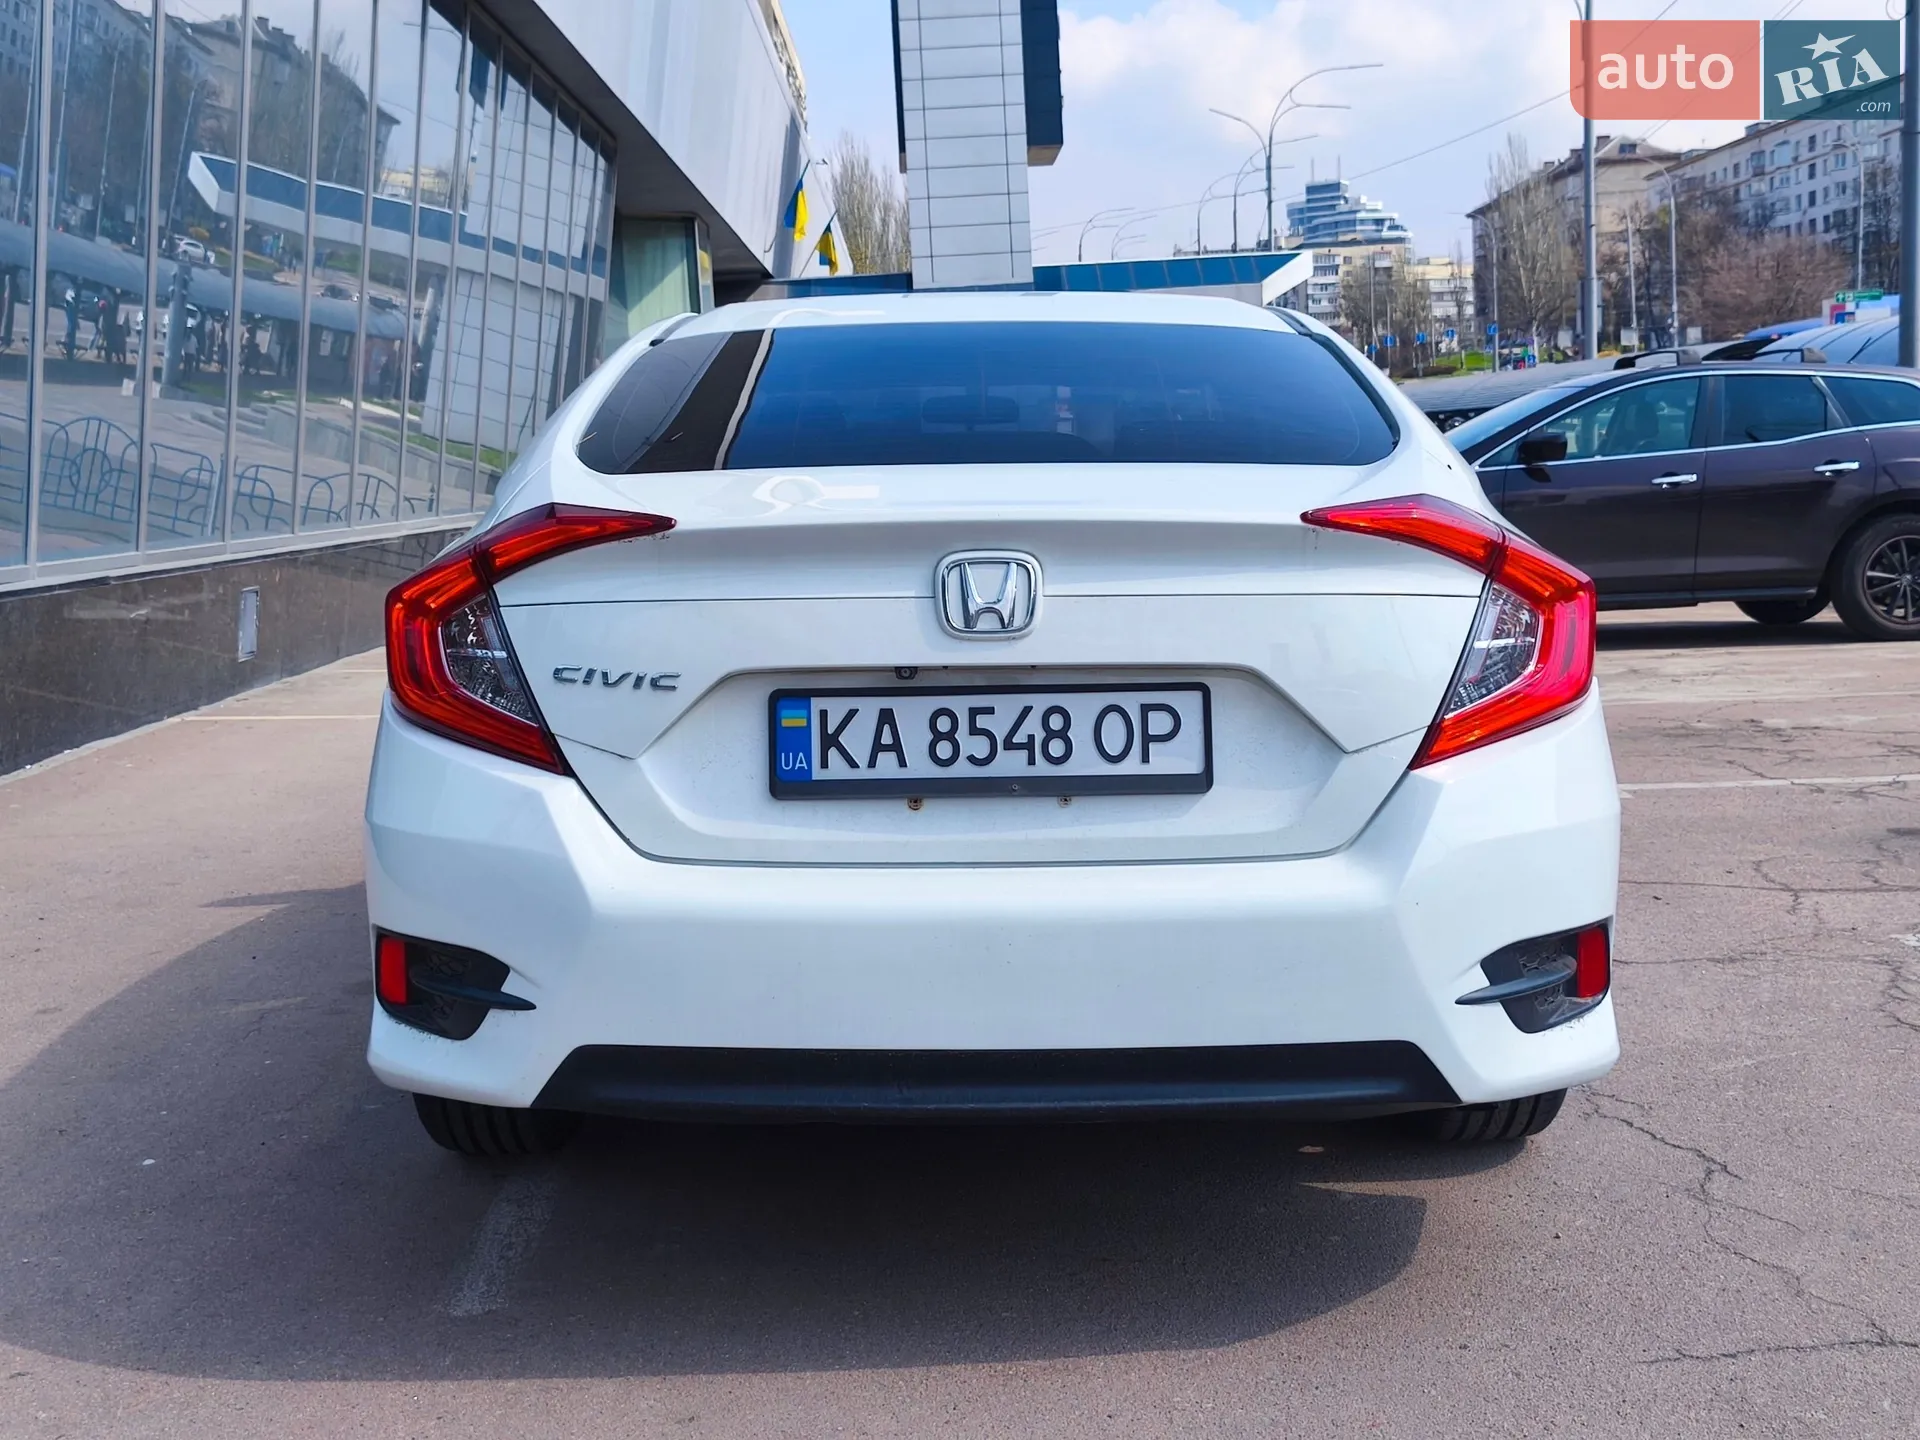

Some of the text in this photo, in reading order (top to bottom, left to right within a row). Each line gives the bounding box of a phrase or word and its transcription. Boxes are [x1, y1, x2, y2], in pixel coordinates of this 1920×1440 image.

[553, 664, 682, 691] CIVIC
[819, 703, 1182, 769] KA 8548 OP
[781, 752, 807, 771] UA
